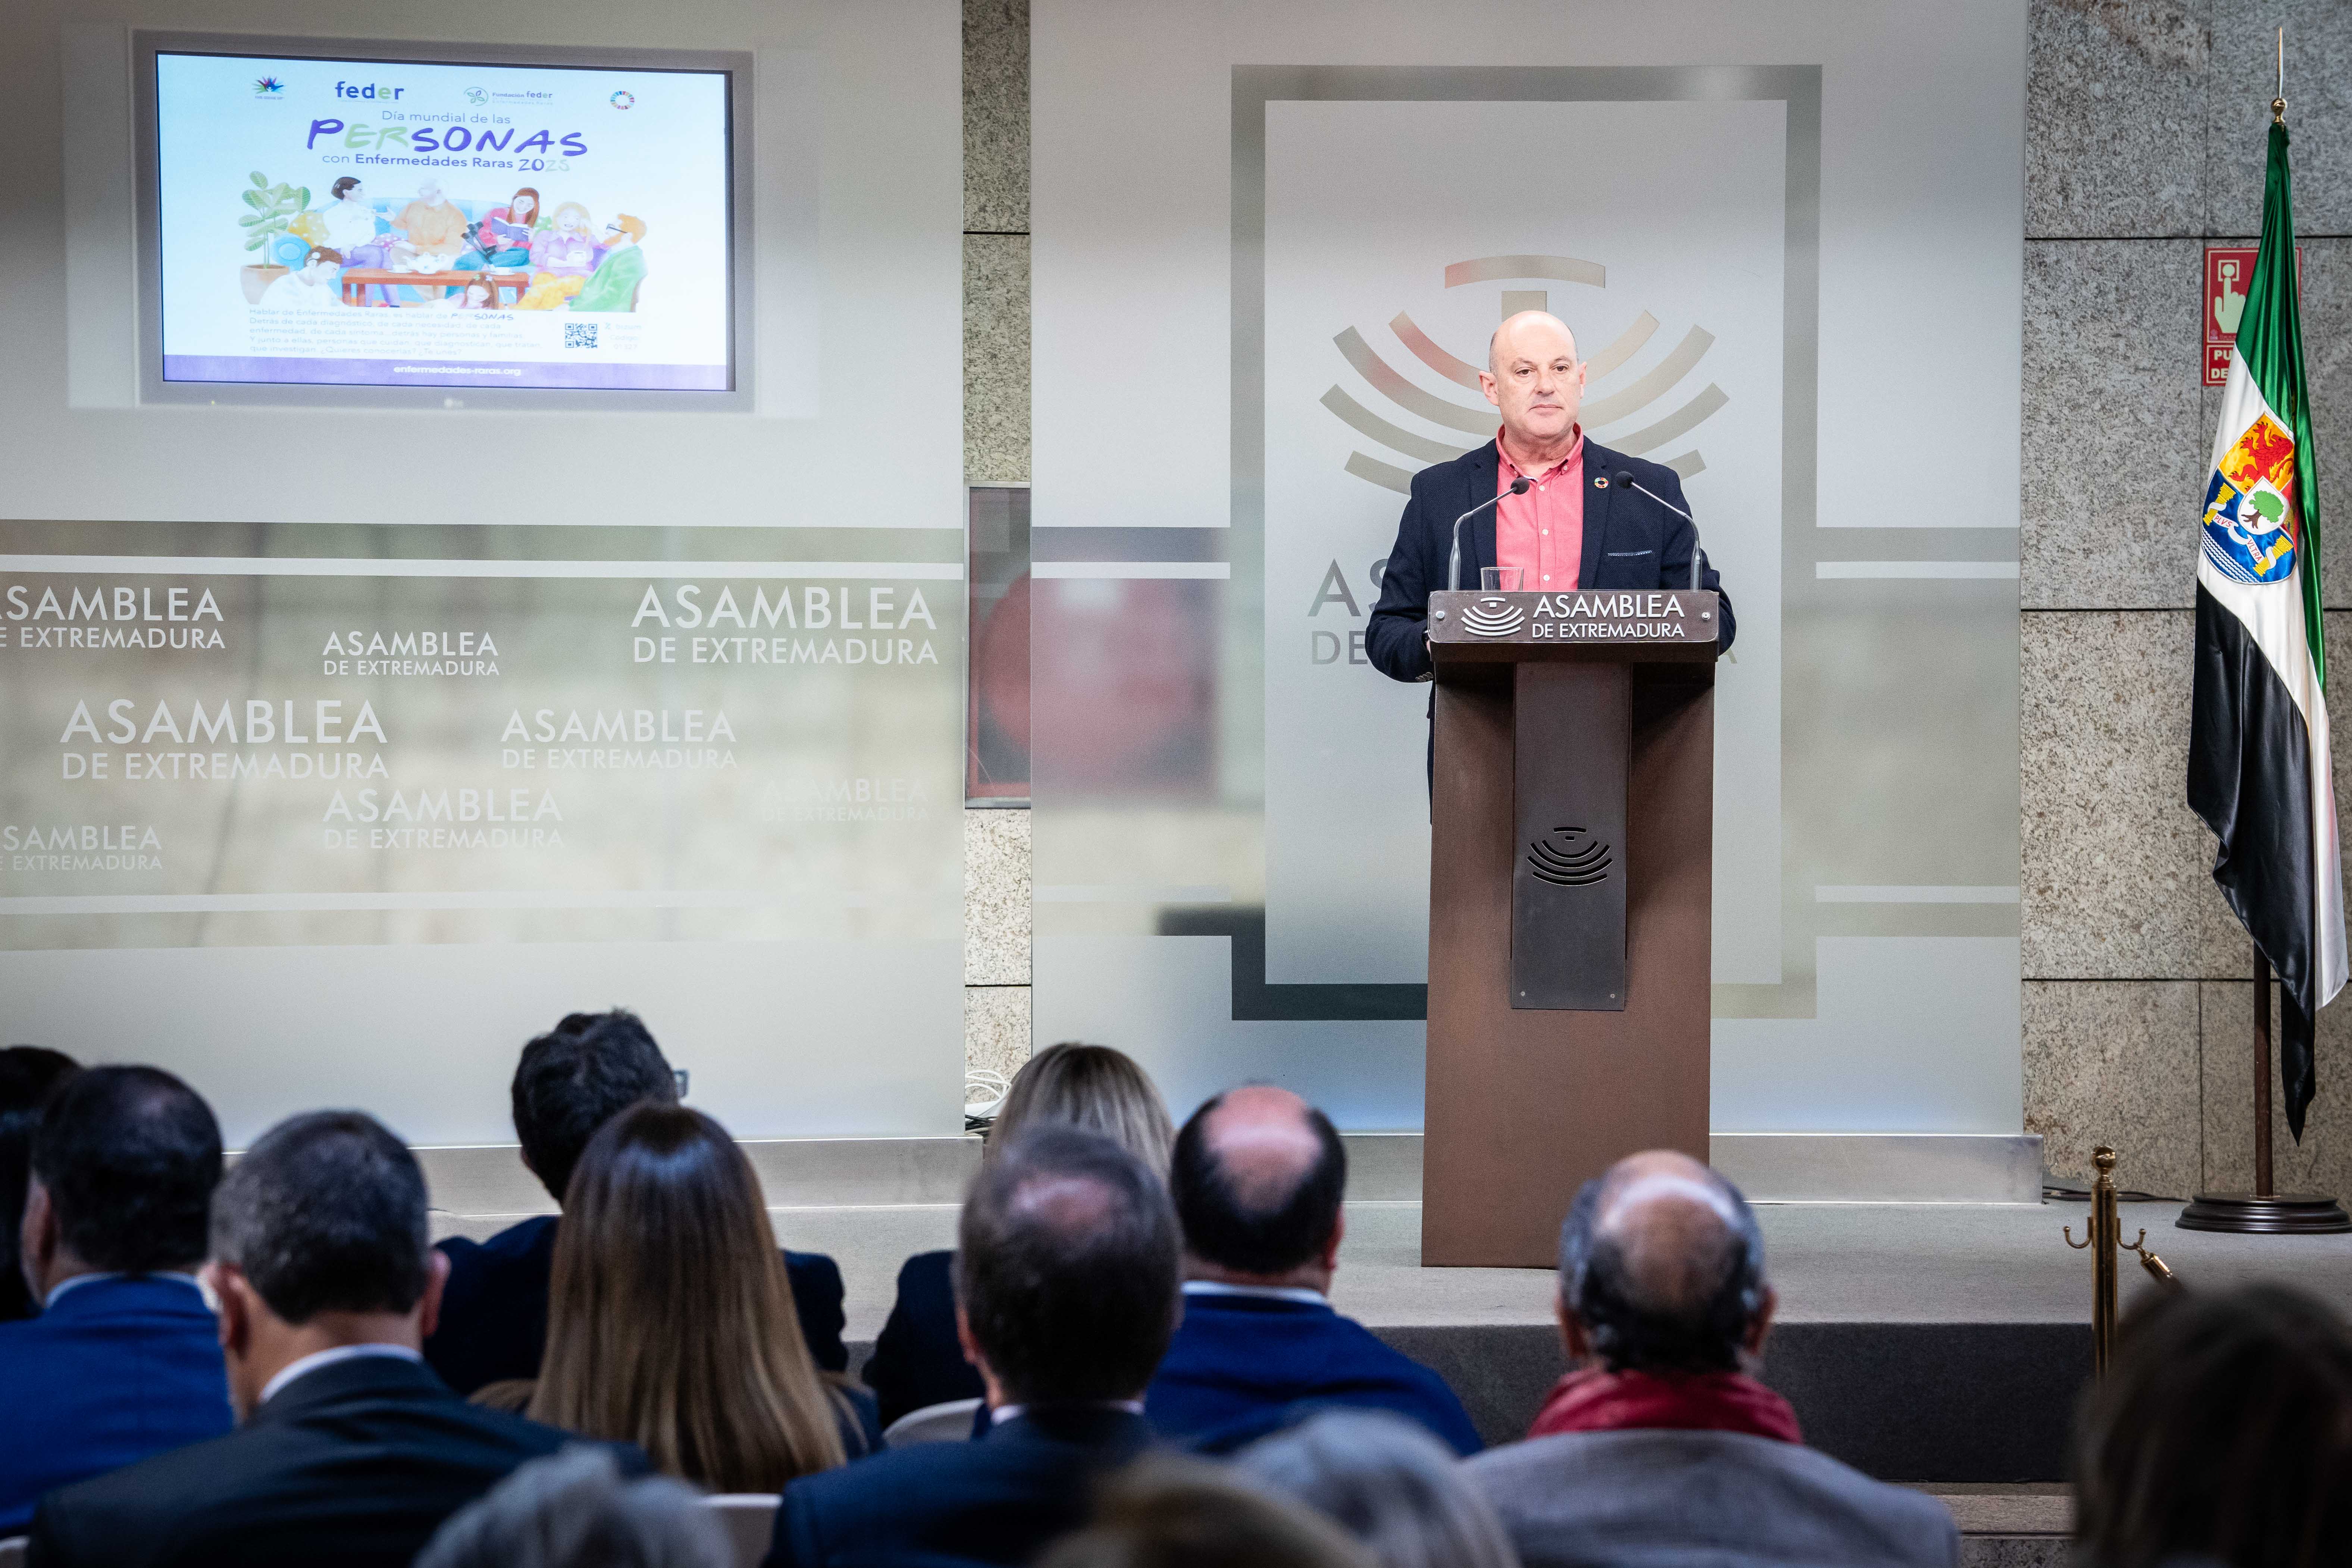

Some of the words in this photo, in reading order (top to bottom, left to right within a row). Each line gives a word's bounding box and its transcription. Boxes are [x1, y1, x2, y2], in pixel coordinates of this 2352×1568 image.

[335, 81, 404, 100] feder
[382, 110, 405, 121] Día
[410, 112, 465, 123] mundial
[470, 113, 488, 123] de
[492, 113, 511, 124] las
[307, 119, 588, 156] PERSONAS
[323, 155, 349, 164] con
[356, 154, 467, 167] Enfermedades
[472, 158, 513, 168] Raras
[518, 159, 570, 172] 2025
[422, 330, 436, 338] hay
[419, 348, 433, 356] ¿Te
[394, 366, 522, 376] enfermedades-raras.org
[2214, 515, 2233, 527] PLVS
[2247, 539, 2262, 561] VLTRA
[0, 585, 224, 621] SAMBLEA
[631, 585, 936, 629] ASAMBLEA
[1533, 595, 1685, 618] ASAMBLEA
[21, 627, 225, 648] EXTREMADURA
[1532, 623, 1553, 638] DE
[1559, 623, 1685, 638] EXTREMADURA
[323, 631, 498, 656] ASAMBLEA
[634, 637, 676, 663] DE
[692, 638, 938, 665] EXTREMADURA
[1312, 630, 1368, 664] DE
[324, 661, 348, 675] DE
[357, 661, 499, 676] EXTREMADURA
[60, 698, 388, 744] ASAMBLEA
[501, 709, 736, 742] ASAMBLEA
[63, 753, 108, 779] DE
[125, 753, 390, 779] EXTREMADURA
[502, 749, 535, 769] DE
[548, 749, 737, 769] EXTREMADURA
[762, 778, 929, 803] ASAMBLEA
[322, 788, 564, 822] ASAMBLEA
[2, 825, 162, 851] SAMBLEA
[325, 829, 358, 849] DE
[370, 829, 565, 849] EXTREMADURA
[13, 855, 163, 871] EXTREMADURA
